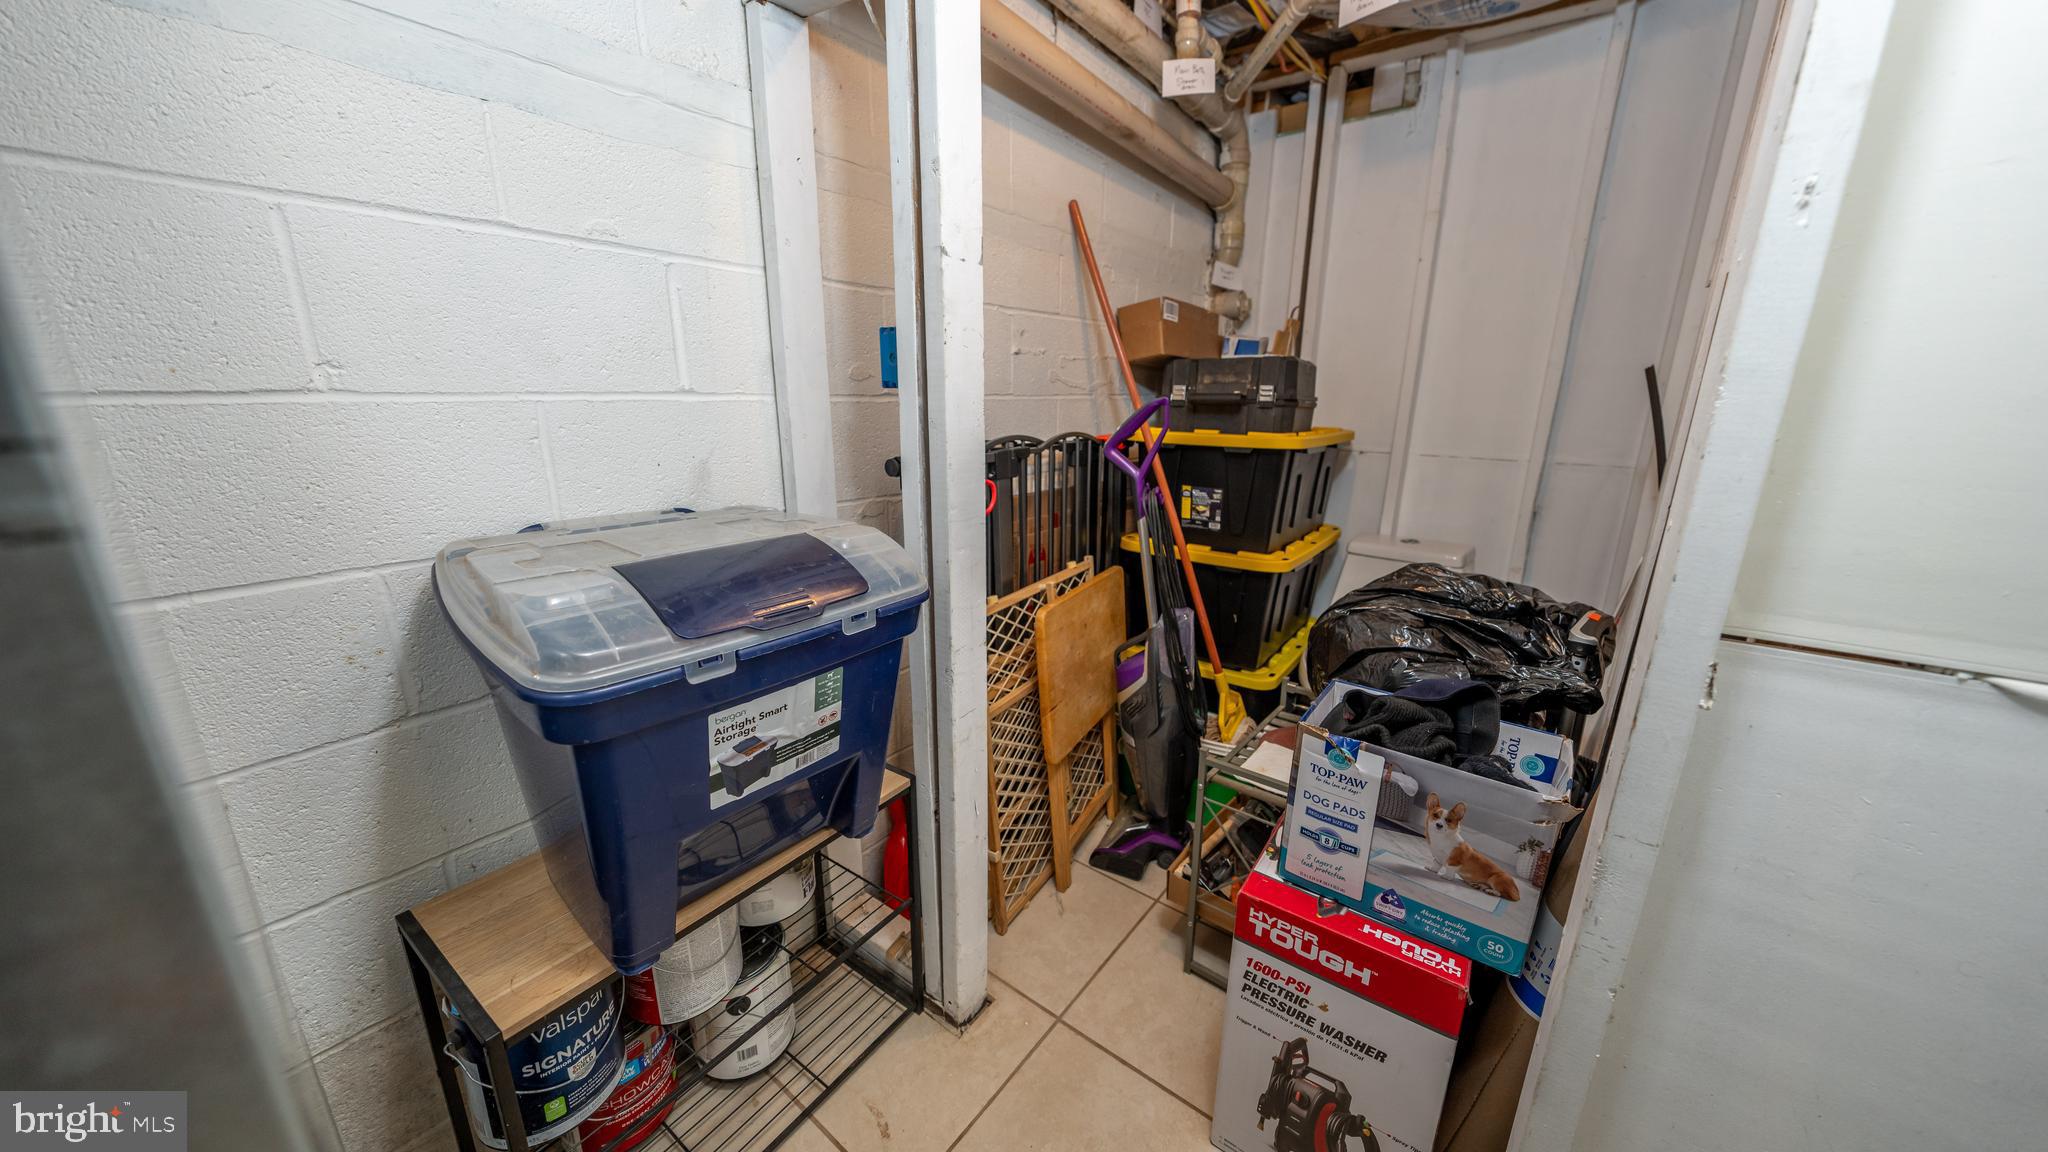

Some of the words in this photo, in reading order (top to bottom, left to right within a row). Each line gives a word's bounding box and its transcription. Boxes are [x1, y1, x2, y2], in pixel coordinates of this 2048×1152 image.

[714, 709, 747, 725] bergan
[714, 716, 756, 737] Airtight
[759, 704, 788, 721] Smart
[714, 725, 757, 746] Storage
[1303, 789, 1330, 808] DOG
[1333, 802, 1366, 820] PADS
[1307, 809, 1332, 822] REGULAR
[1332, 818, 1343, 826] SIZE
[1344, 822, 1356, 830] PAD
[1302, 829, 1319, 840] HOLDS
[1341, 844, 1355, 853] CUPS
[1301, 859, 1313, 868] leak
[1314, 867, 1346, 881] protection
[1314, 857, 1333, 868] layers
[1249, 907, 1319, 944] HYPER
[1420, 909, 1443, 921] Absorbs
[1444, 919, 1467, 932] quickly
[1421, 917, 1441, 928] reduce
[1441, 925, 1471, 943] splashing
[1362, 924, 1461, 972] TOUGH
[1431, 929, 1457, 944] tracking
[1486, 940, 1504, 953] 50
[1248, 916, 1372, 987] TOUGH
[1400, 947, 1462, 978] HYPER
[1483, 948, 1505, 959] COUNT
[1243, 970, 1310, 1009] ELECTRIC
[1245, 957, 1311, 996] 1600-PSI
[1240, 995, 1264, 1010] Lavadora
[1241, 983, 1317, 1028] PRESSURE
[1320, 1022, 1388, 1063] WASHER
[521, 999, 615, 1078] SIGNATURE
[540, 1058, 572, 1079] INTERIOR
[573, 1045, 591, 1060] PAINT
